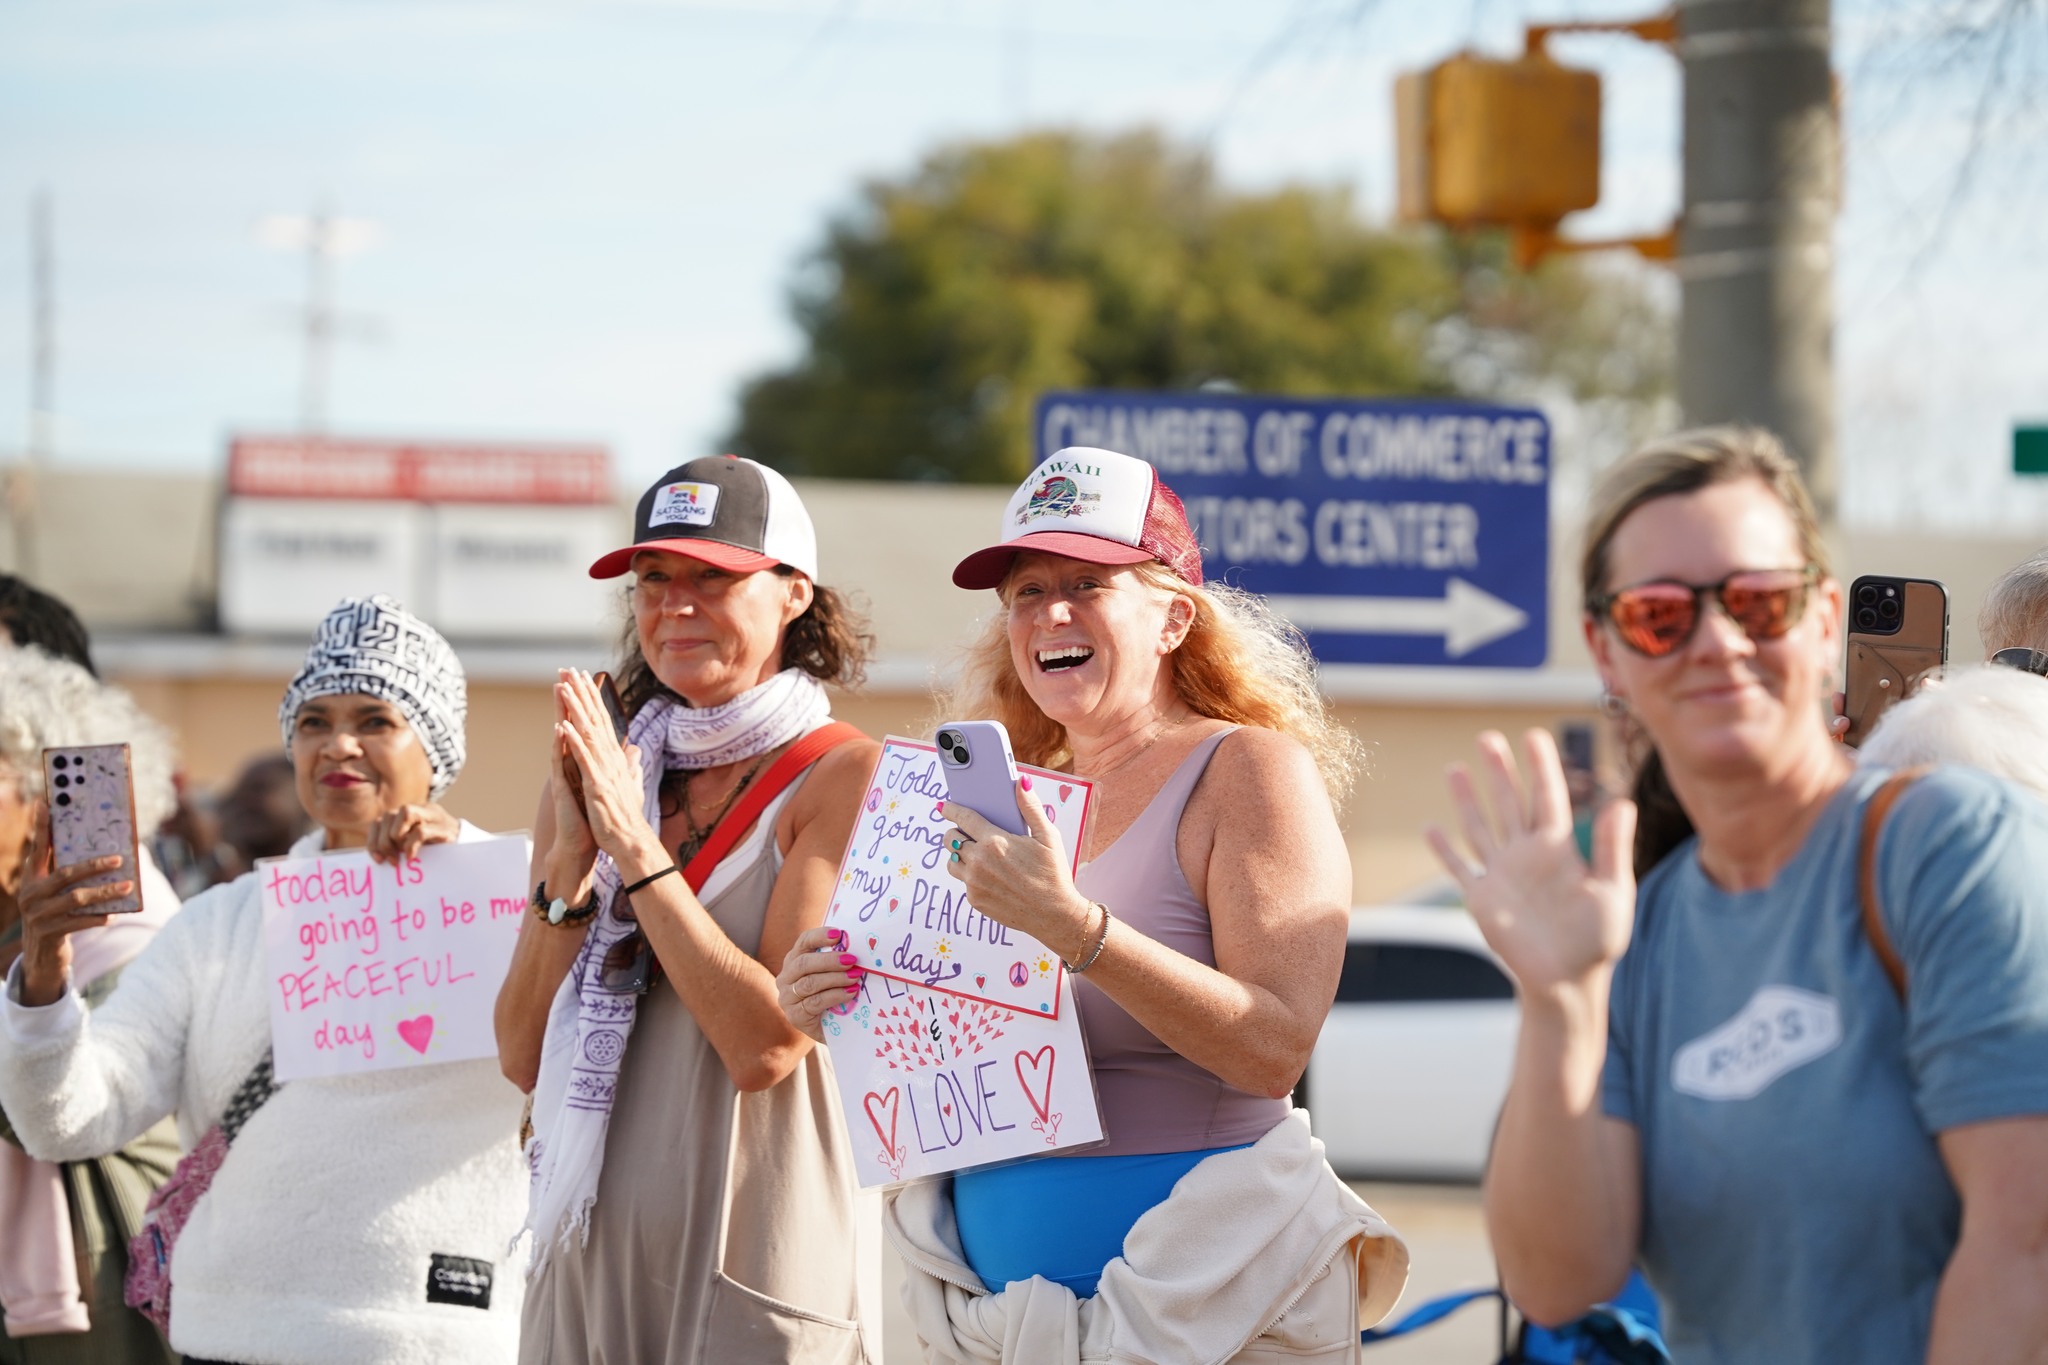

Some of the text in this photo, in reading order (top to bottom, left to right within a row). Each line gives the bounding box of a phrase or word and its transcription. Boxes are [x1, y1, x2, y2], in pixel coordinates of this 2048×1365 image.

[1044, 404, 1547, 485] CHAMBER OF COMMERCE
[1023, 461, 1101, 491] HAWAII
[656, 505, 706, 517] SATSANG
[1313, 499, 1479, 570] CENTER
[886, 753, 951, 822] Toda
[867, 815, 946, 869] going
[267, 860, 374, 912] today
[851, 867, 891, 922] my
[908, 878, 1014, 947] PEACEFUL
[299, 912, 380, 961] going
[390, 900, 426, 941] to
[440, 897, 476, 928] be
[277, 953, 475, 1012] PEACEFUL
[892, 932, 962, 987] day
[314, 1020, 376, 1060] day
[907, 1060, 1016, 1154] LOVE
